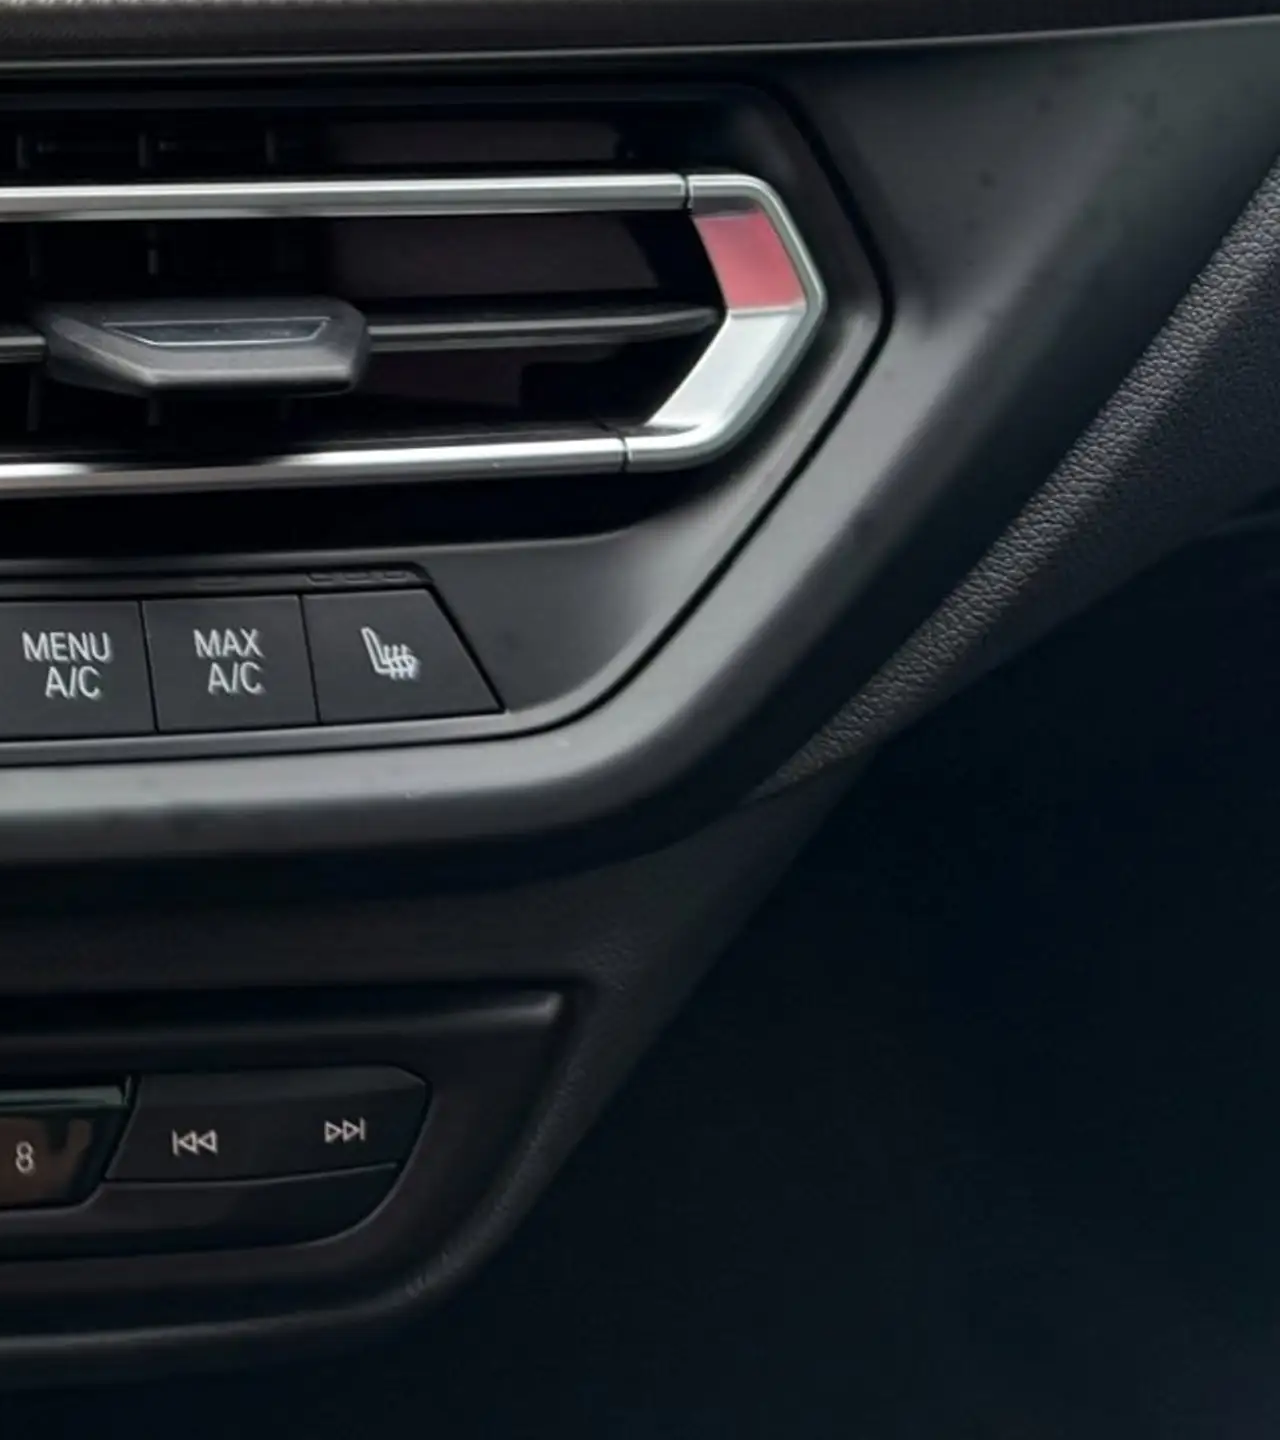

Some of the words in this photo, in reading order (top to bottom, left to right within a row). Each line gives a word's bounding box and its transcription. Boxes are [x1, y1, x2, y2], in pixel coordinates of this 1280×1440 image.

[22, 631, 111, 663] MENU
[194, 628, 262, 658] MAX
[44, 666, 101, 699] A/C
[207, 661, 262, 694] A/C
[16, 1143, 34, 1173] 8
